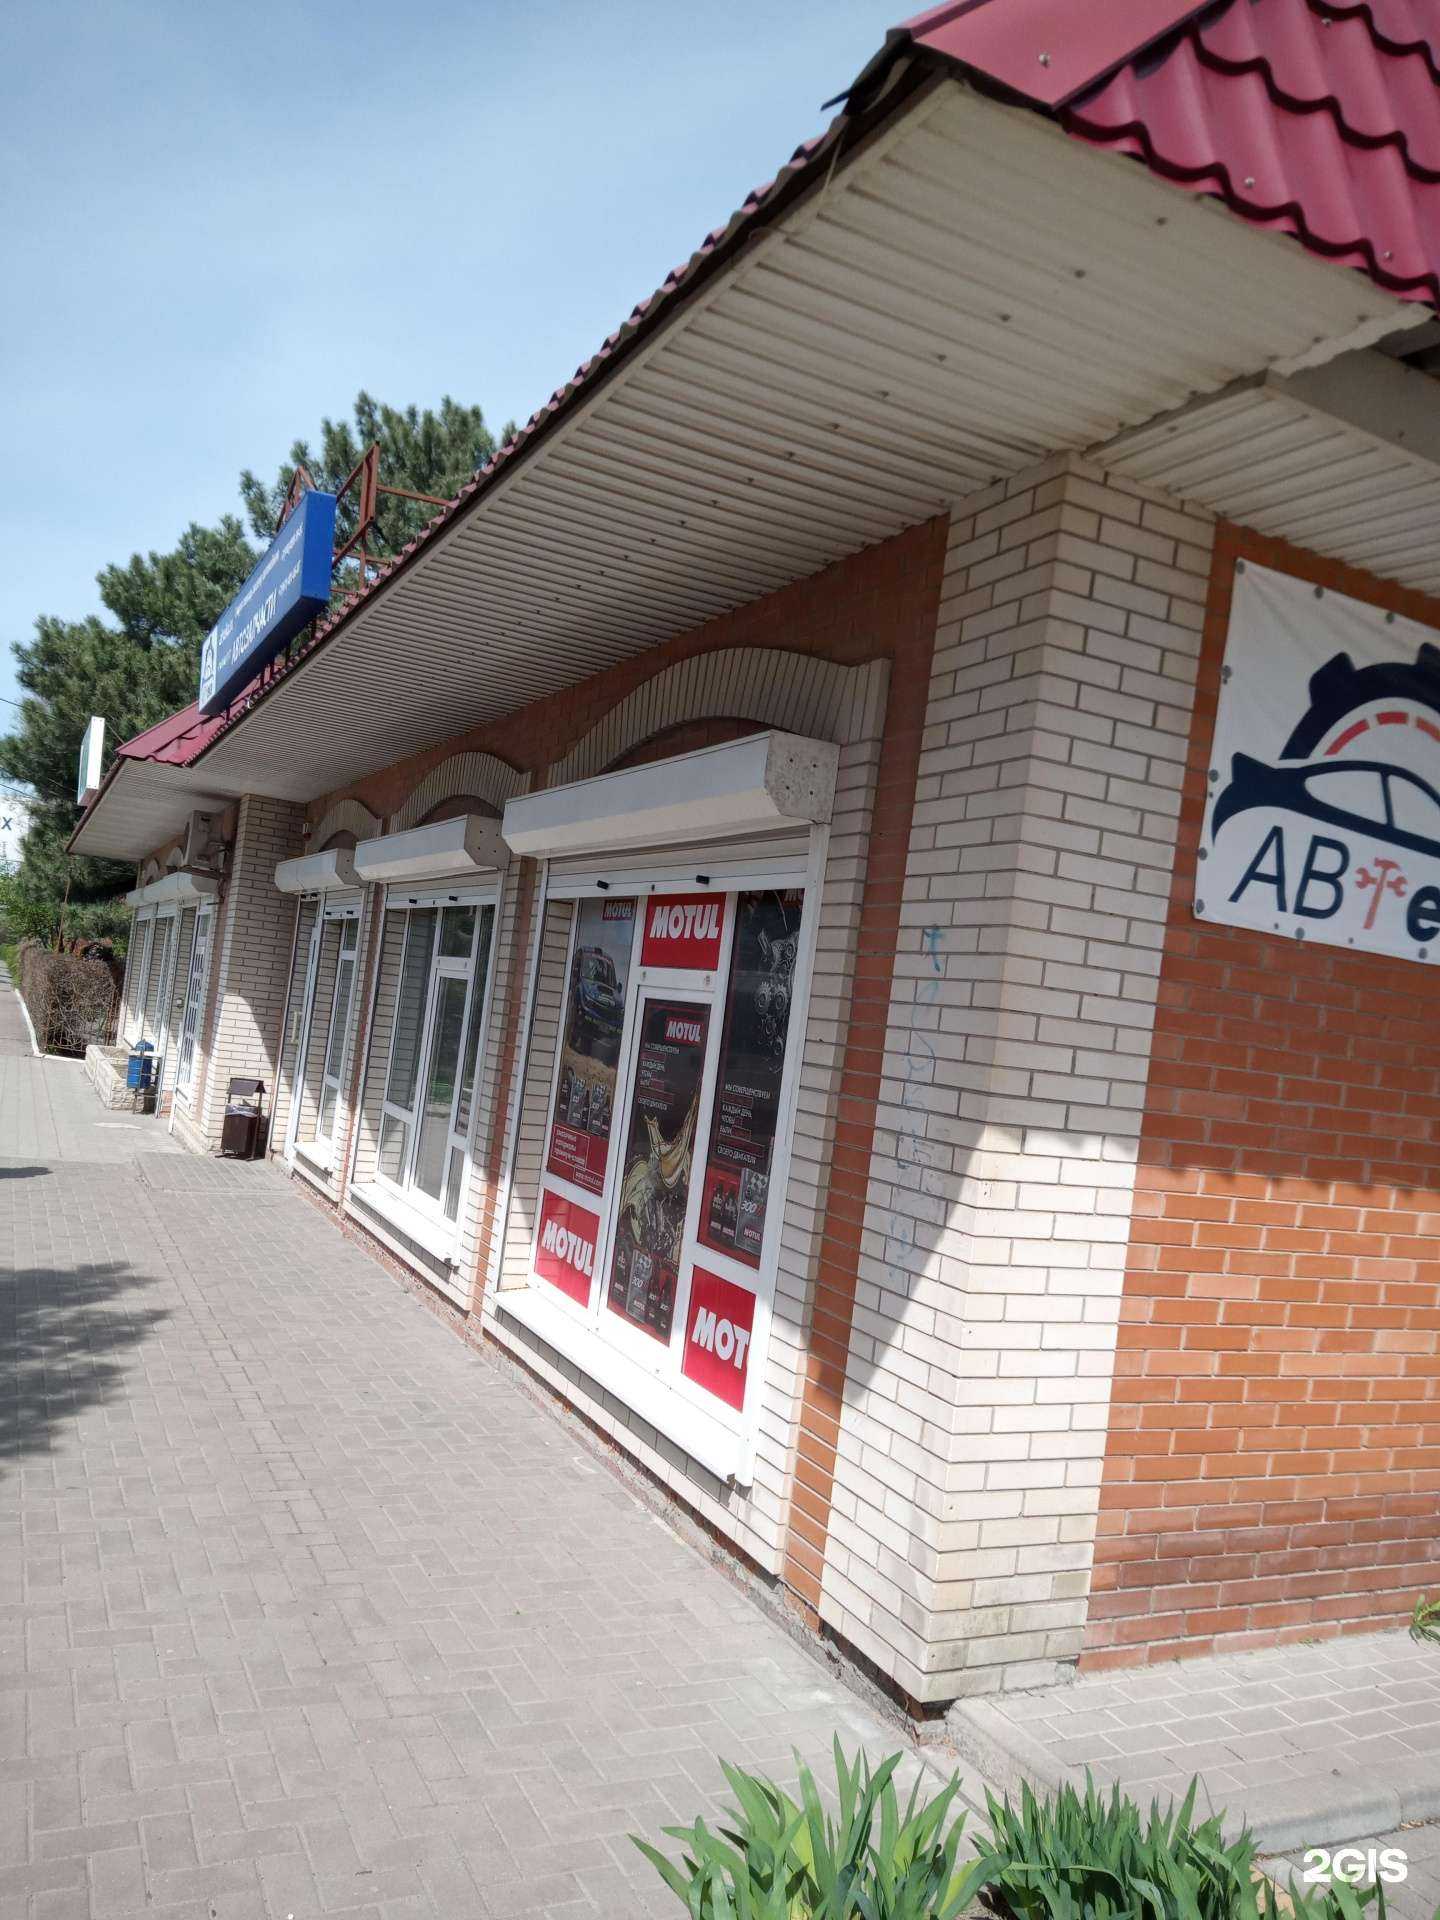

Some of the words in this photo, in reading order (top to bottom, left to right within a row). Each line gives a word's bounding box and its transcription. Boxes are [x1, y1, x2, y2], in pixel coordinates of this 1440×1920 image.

[604, 902, 633, 919] MOTUL
[649, 903, 720, 940] MOTUL
[666, 1020, 701, 1042] MOTUL
[541, 1219, 593, 1277] MOTUL
[691, 1305, 751, 1370] MOT
